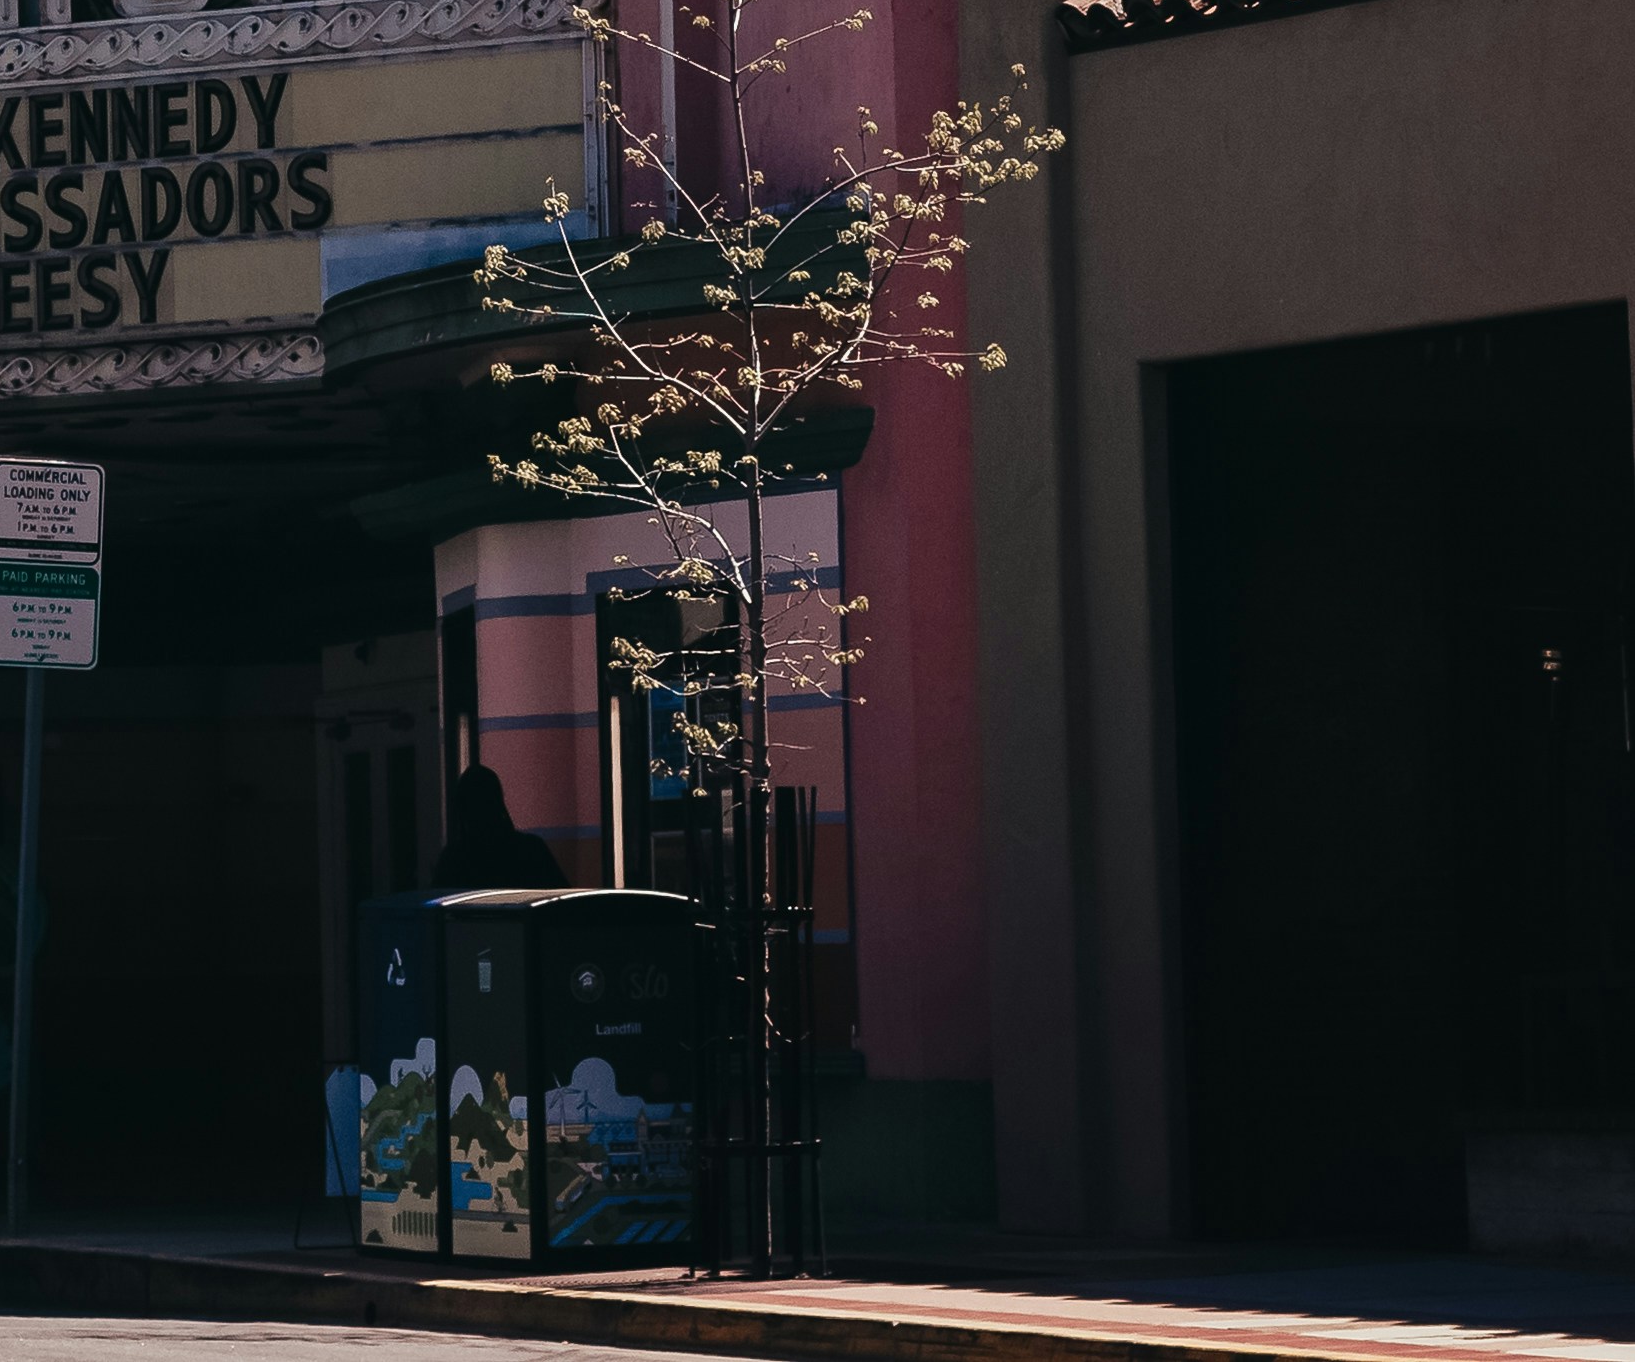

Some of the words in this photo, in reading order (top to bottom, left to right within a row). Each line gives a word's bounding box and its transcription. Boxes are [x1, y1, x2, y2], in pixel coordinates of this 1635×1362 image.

[9, 469, 86, 485] COMMERCIAL
[4, 486, 54, 500] LOADING
[60, 489, 91, 502] ONLY
[17, 502, 23, 513] 7
[53, 505, 60, 514] 6
[51, 524, 57, 533] 6
[2, 570, 28, 583] PAID
[35, 572, 86, 585] PARKING
[12, 602, 19, 612] 6
[49, 604, 56, 613] 9
[11, 628, 18, 638] 6
[48, 630, 55, 639] 9
[595, 1022, 642, 1036] Landfill
